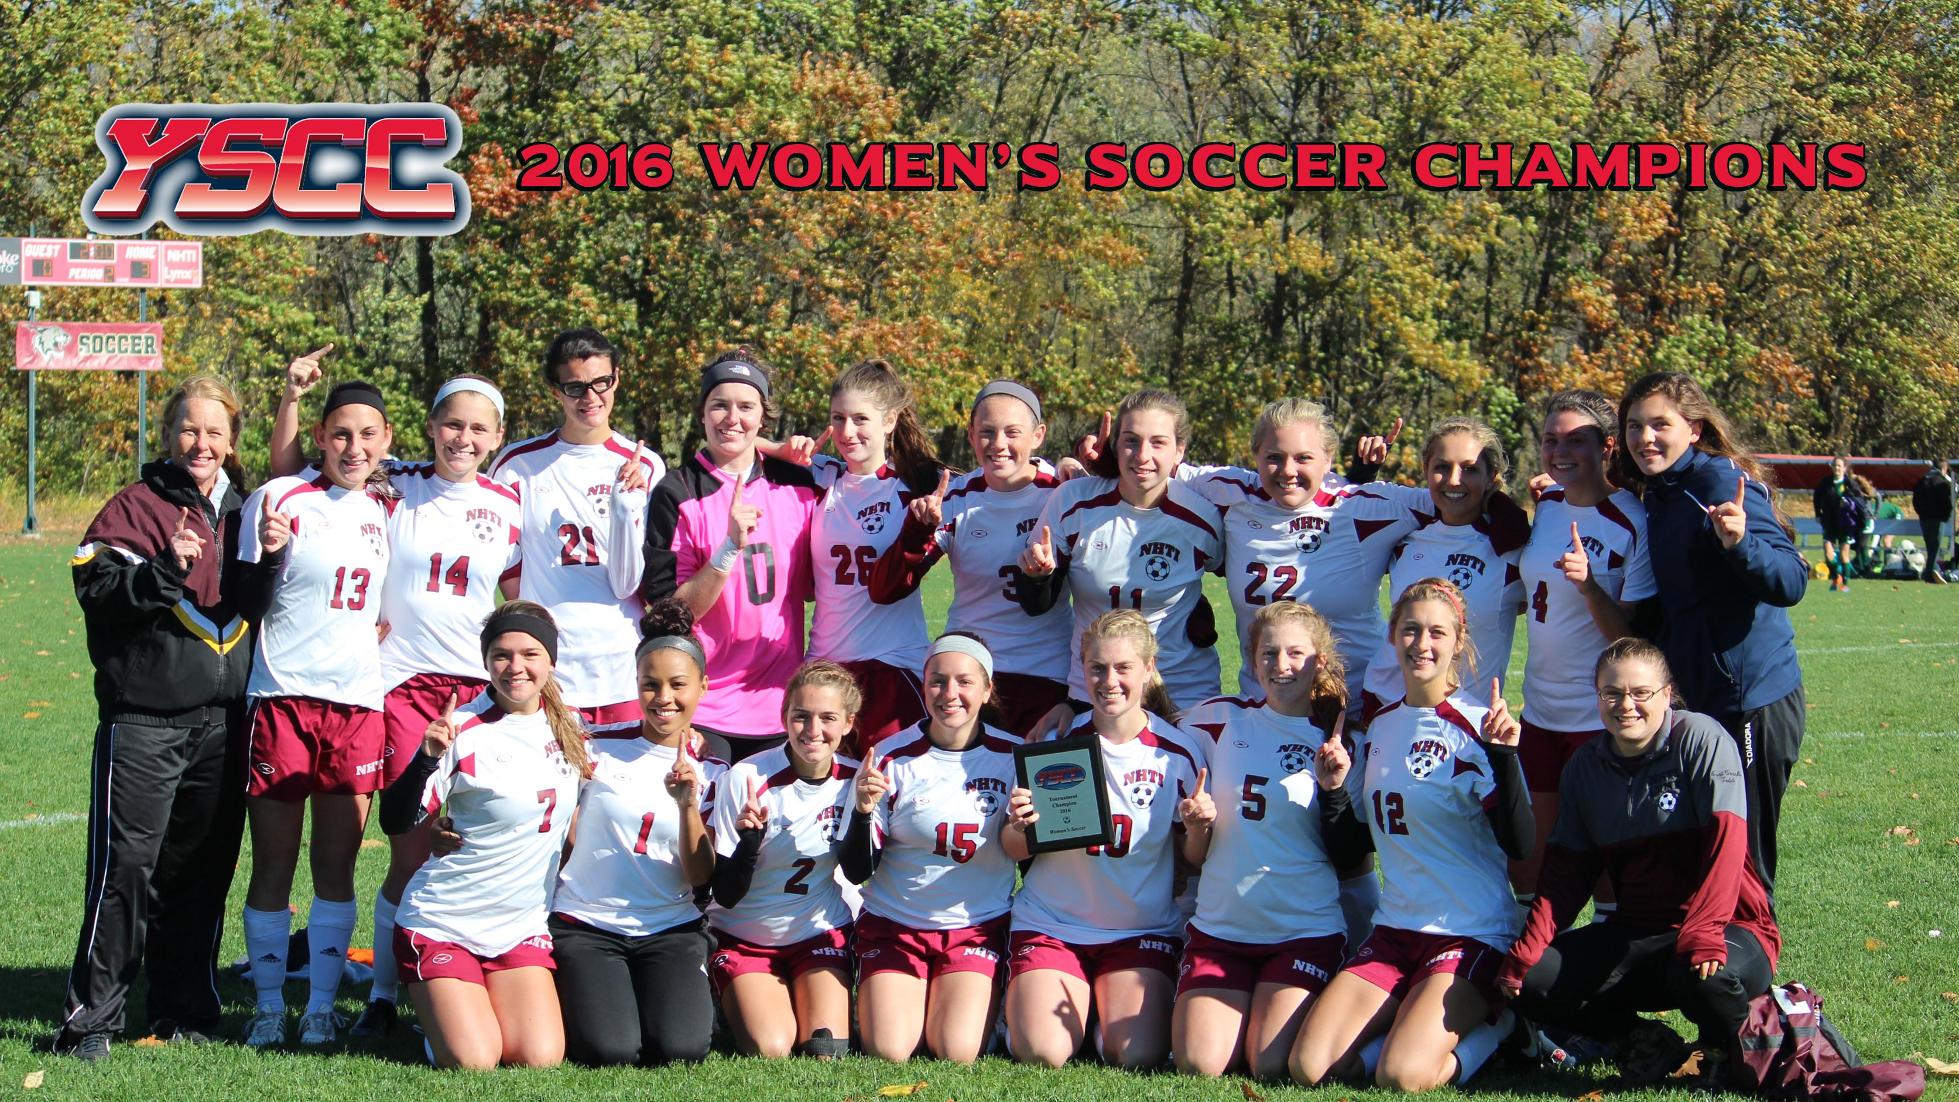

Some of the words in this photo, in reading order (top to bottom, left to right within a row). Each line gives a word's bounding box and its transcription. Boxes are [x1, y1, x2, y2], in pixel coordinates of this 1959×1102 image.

[24, 243, 62, 257] GUEST
[125, 245, 157, 259] HOME
[166, 249, 197, 263] NHTI
[68, 267, 104, 280] PERIOD
[78, 333, 157, 356] SOCCER
[466, 508, 502, 528] NHTI
[857, 501, 892, 521] NHTI
[1289, 516, 1331, 535] NHTI
[557, 523, 600, 567] 21
[1139, 543, 1181, 563] NHTI
[426, 552, 470, 597] 14
[743, 543, 777, 605] 0
[830, 545, 878, 587] 26
[1445, 553, 1486, 575] NHTI
[330, 566, 371, 611] 13
[1245, 562, 1299, 605] 22
[1109, 585, 1143, 609] 11
[1532, 580, 1549, 624] 4
[1409, 739, 1448, 763] NHTI
[1745, 721, 1753, 757] DIADORA
[355, 758, 384, 776] NHT
[1123, 769, 1164, 788] NHTI
[965, 777, 1007, 796] NHTI
[1241, 774, 1270, 821] 5
[537, 788, 556, 833] 7
[1372, 790, 1409, 836] 12
[633, 812, 656, 855] 1
[932, 822, 980, 864] 15
[784, 858, 817, 895] 2
[1292, 959, 1329, 982] NHTI
